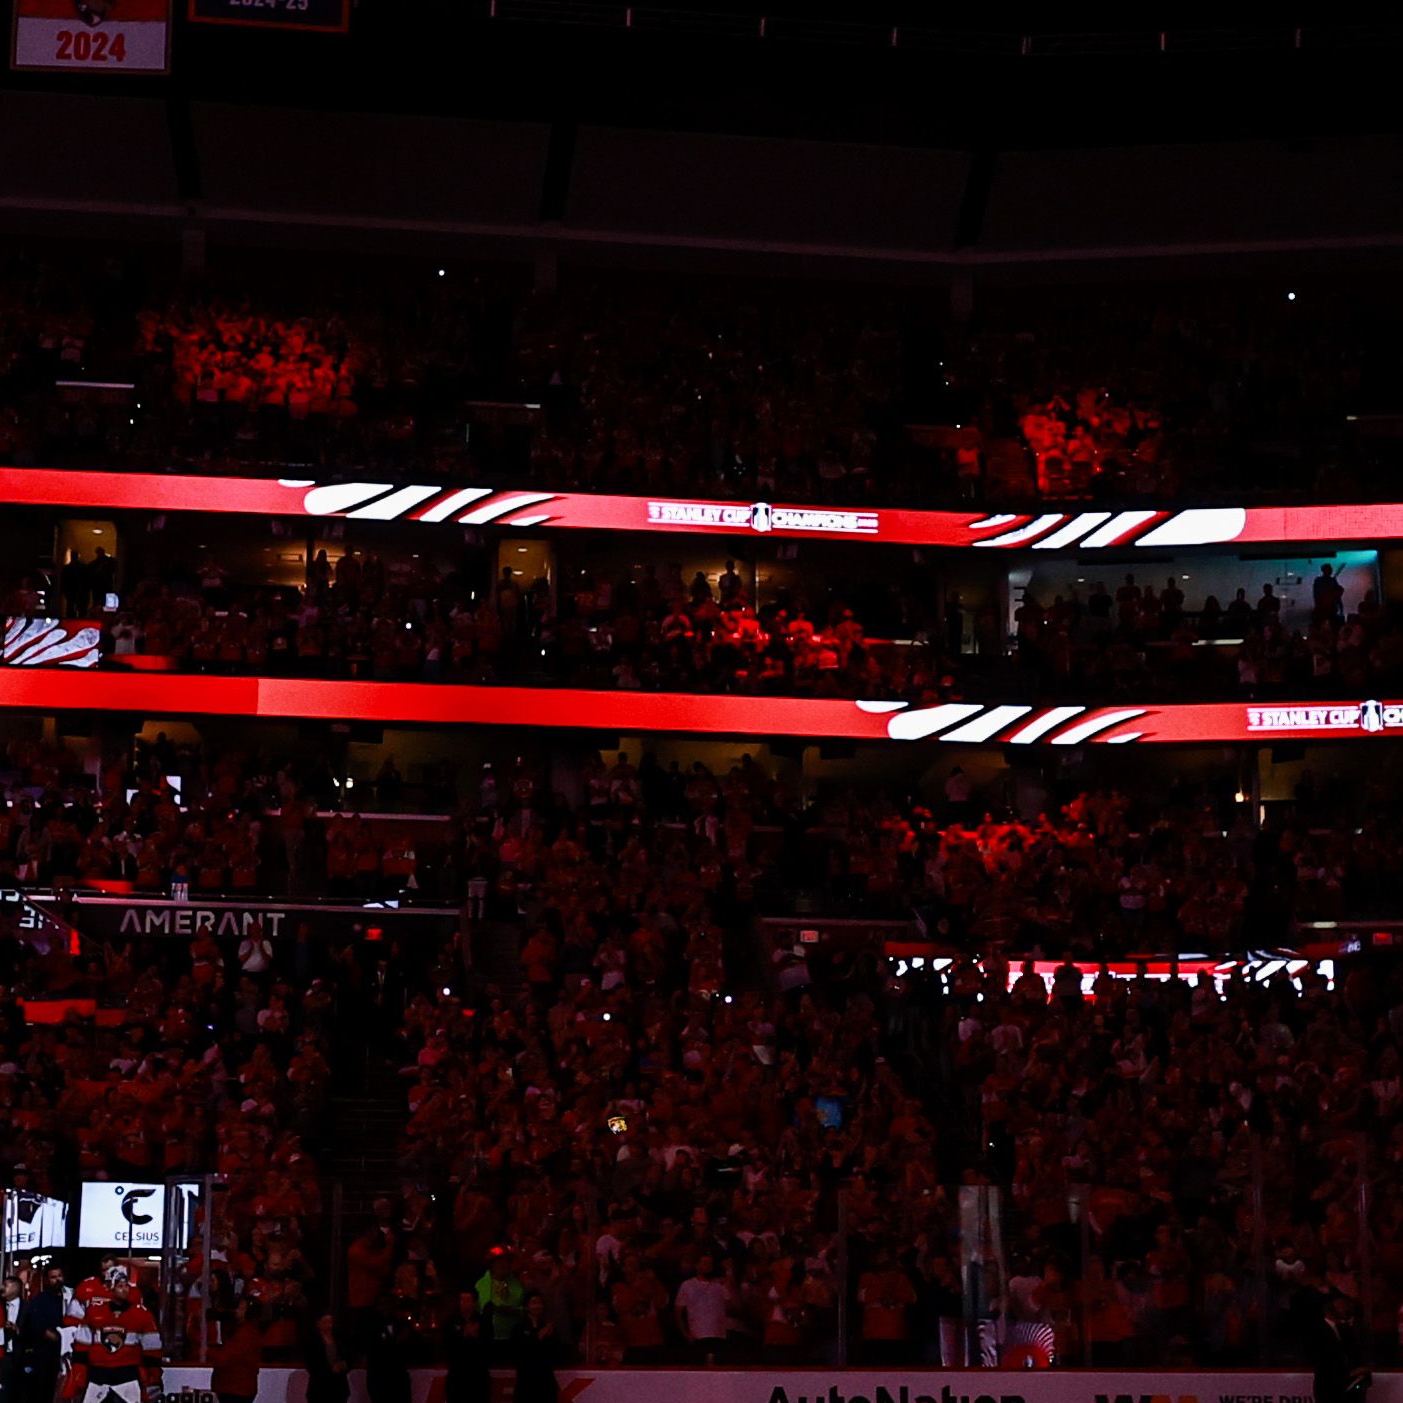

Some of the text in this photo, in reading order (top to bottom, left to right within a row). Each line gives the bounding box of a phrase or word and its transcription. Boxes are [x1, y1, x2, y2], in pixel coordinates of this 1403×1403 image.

[56, 31, 125, 62] 2024
[119, 909, 286, 937] AMERANT
[114, 1231, 160, 1242] CELSIUS
